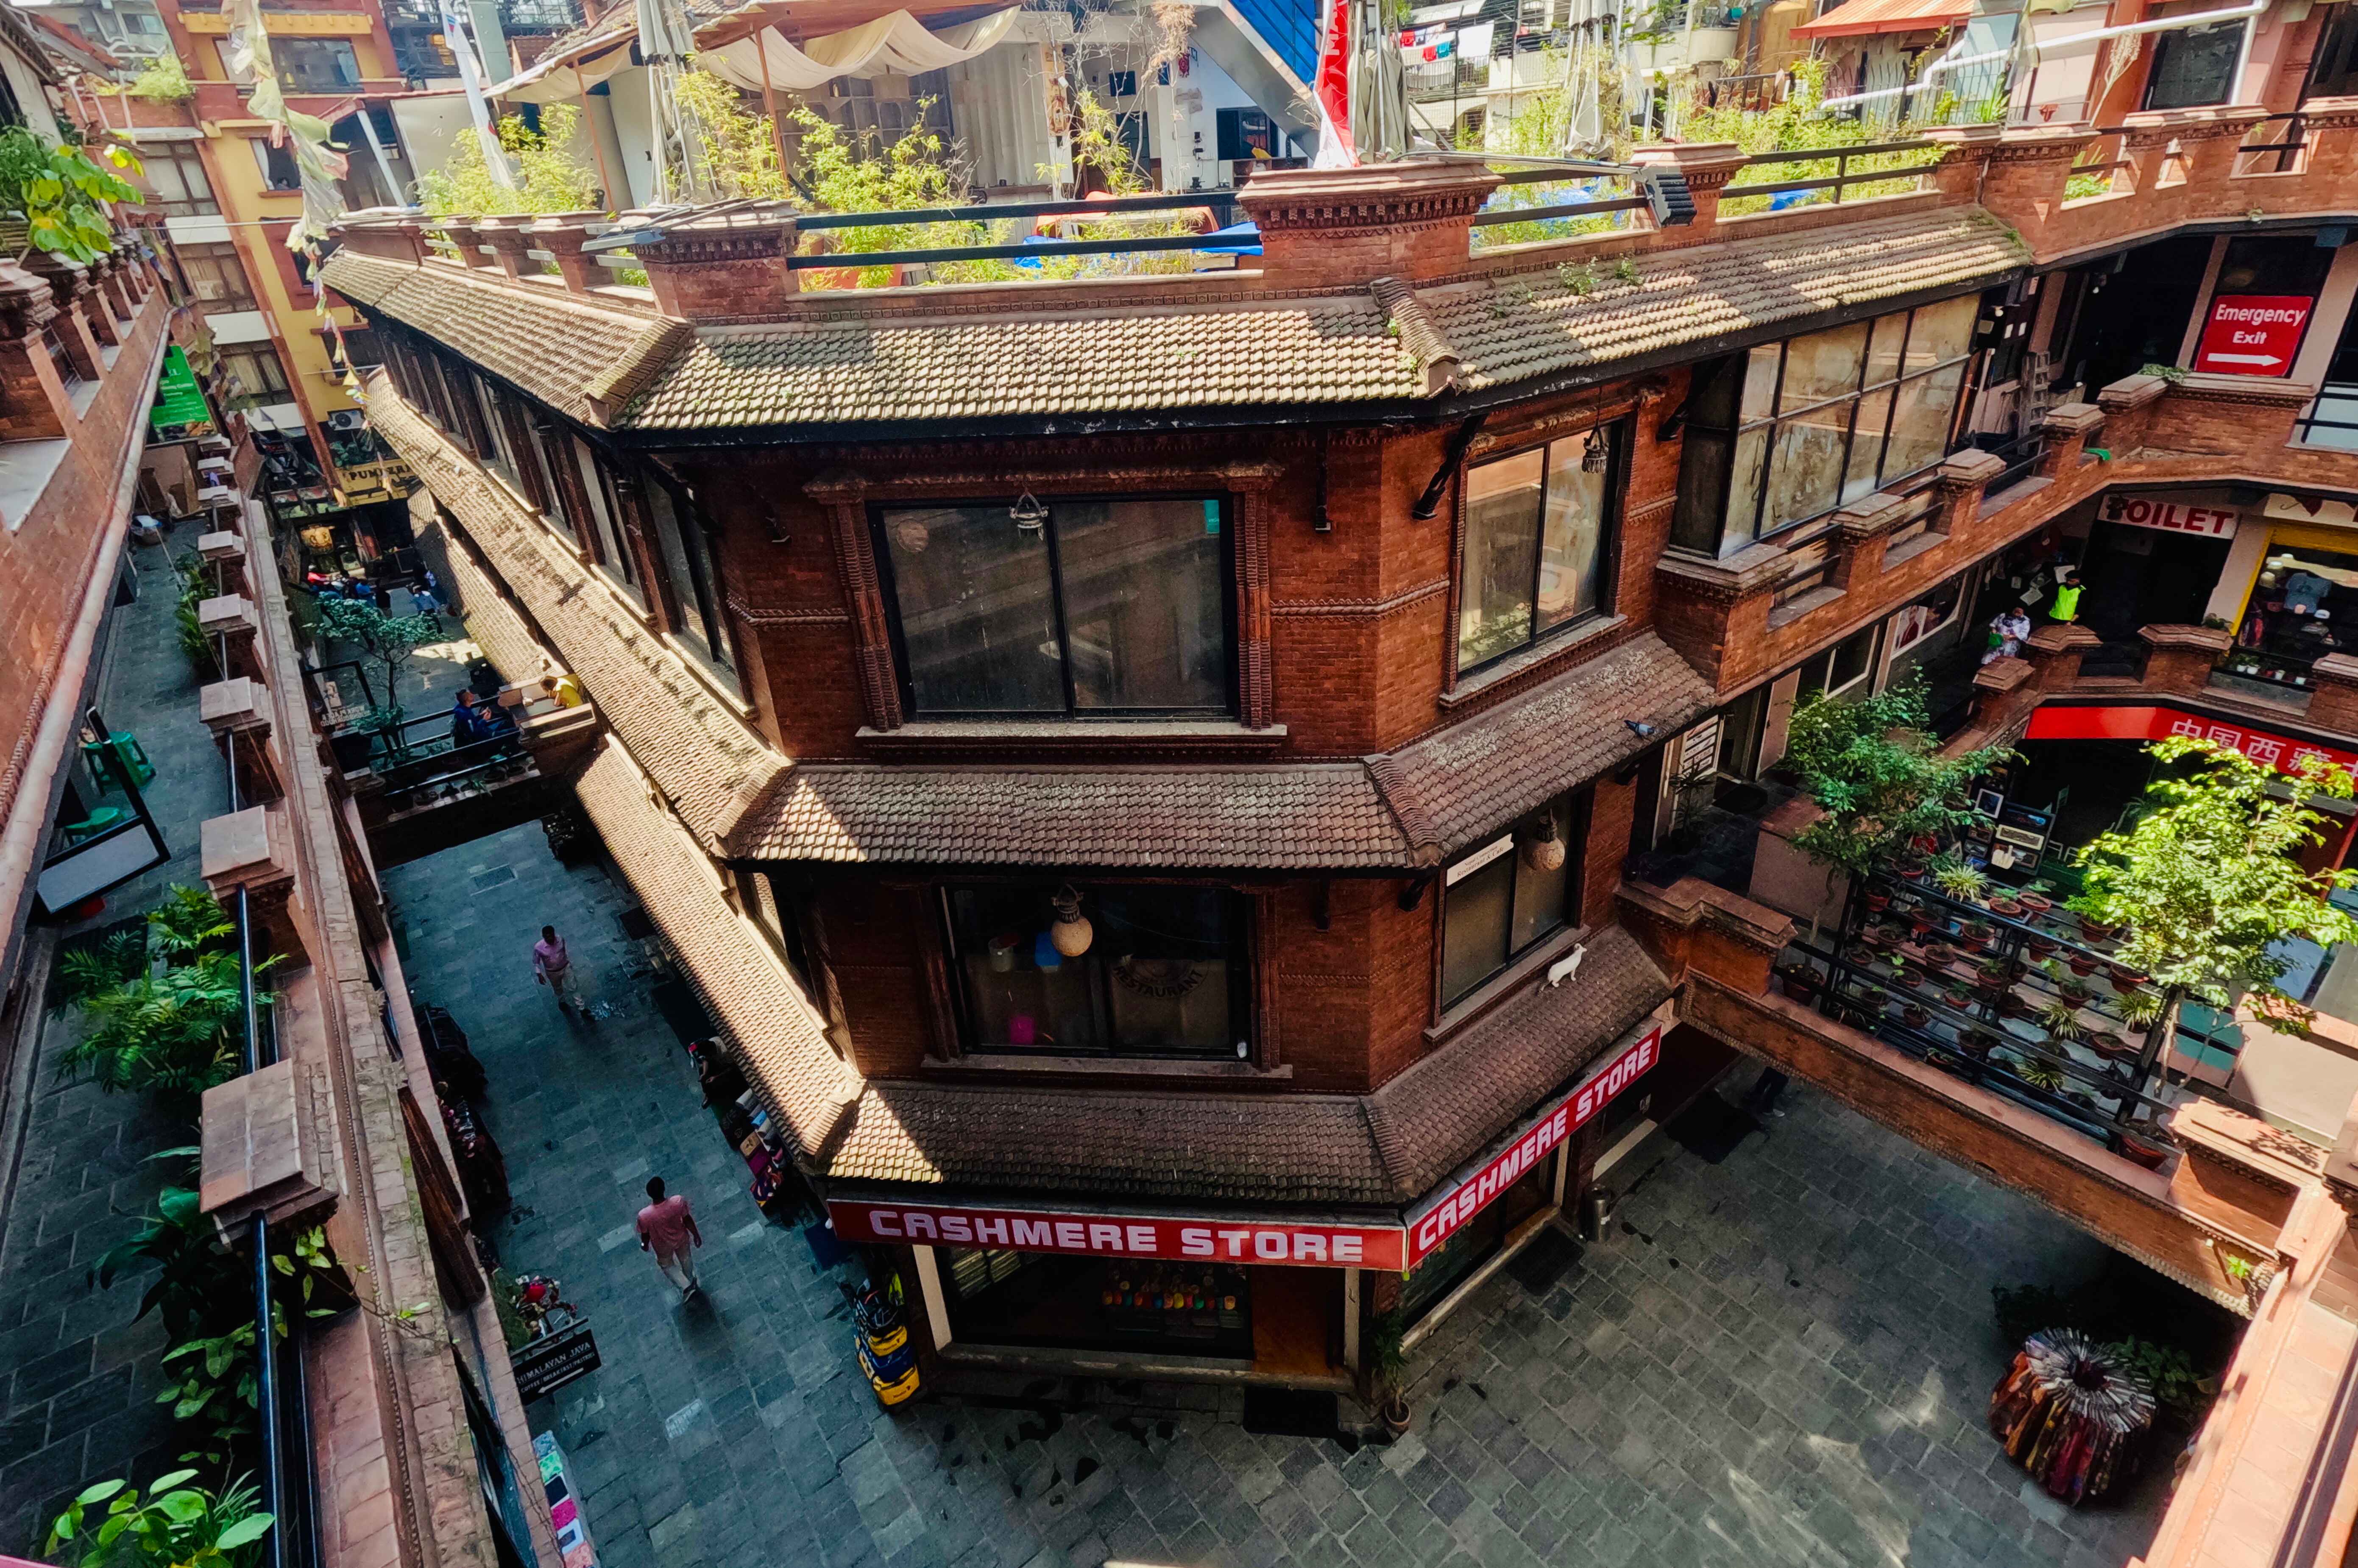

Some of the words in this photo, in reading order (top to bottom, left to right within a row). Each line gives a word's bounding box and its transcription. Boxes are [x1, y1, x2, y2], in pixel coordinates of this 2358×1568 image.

[2215, 304, 2306, 326] Emergency
[2233, 331, 2267, 344] Exit
[2107, 497, 2234, 534] OILET
[1457, 858, 1485, 877] Restaurant
[1112, 966, 1202, 997] RESTAURANT
[1419, 1107, 1567, 1251] CASHMERE
[1576, 1039, 1653, 1122] STORE
[869, 1210, 1157, 1251] CASHMERE
[1182, 1228, 1363, 1262] STORE
[517, 1354, 566, 1384] HIMALAYAN
[570, 1342, 591, 1358] JAVA
